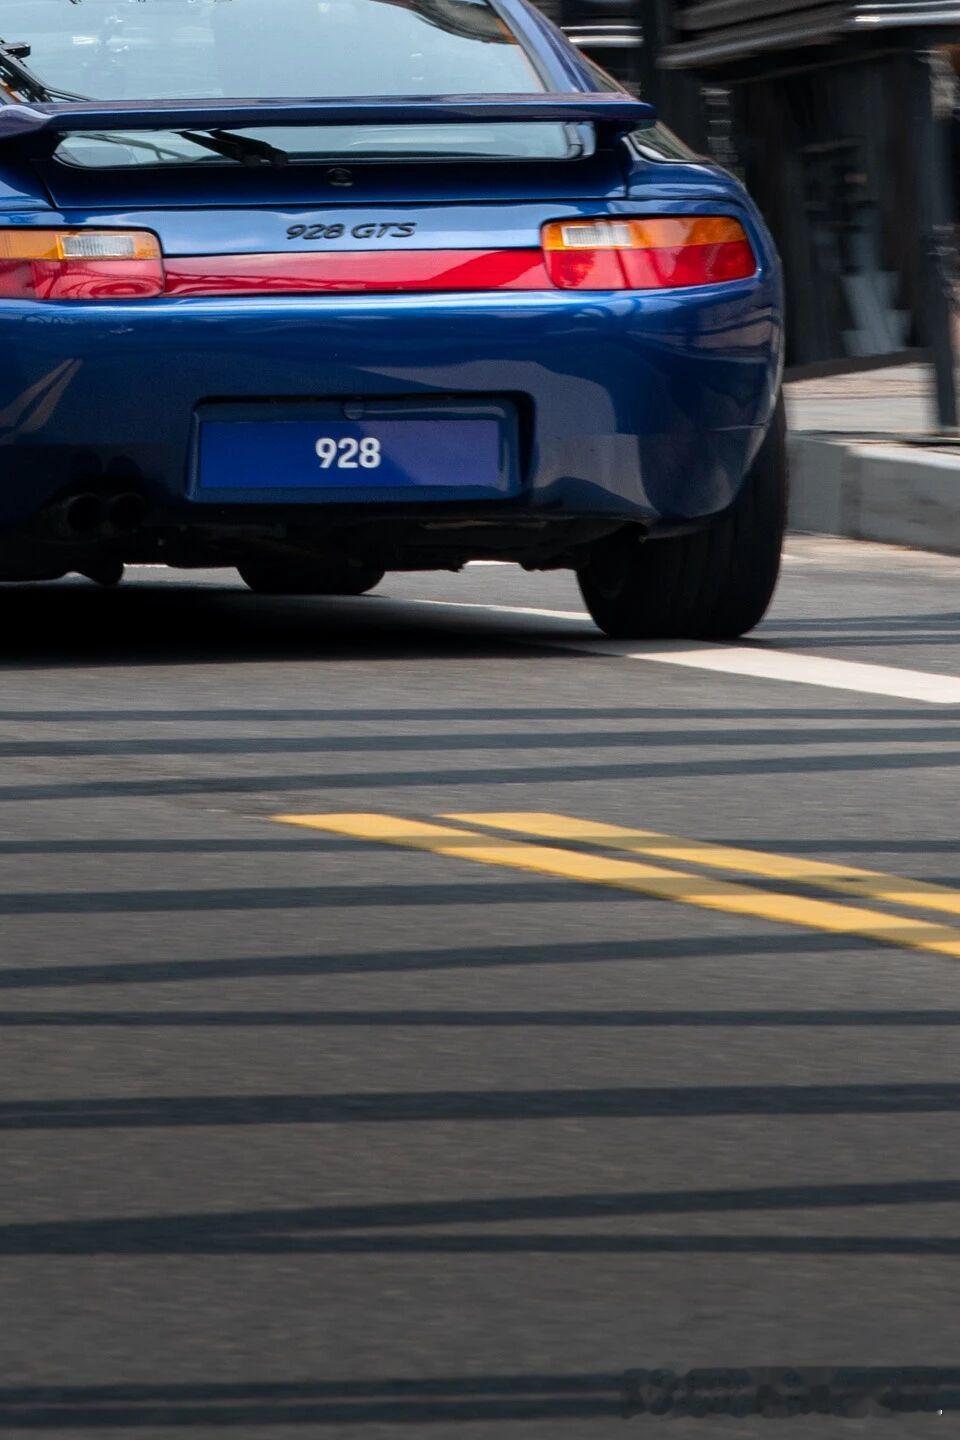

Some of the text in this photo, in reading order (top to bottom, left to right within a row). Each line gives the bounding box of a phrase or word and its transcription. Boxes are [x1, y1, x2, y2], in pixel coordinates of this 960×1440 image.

[286, 222, 417, 240] 928 GTS
[315, 437, 381, 468] 928
